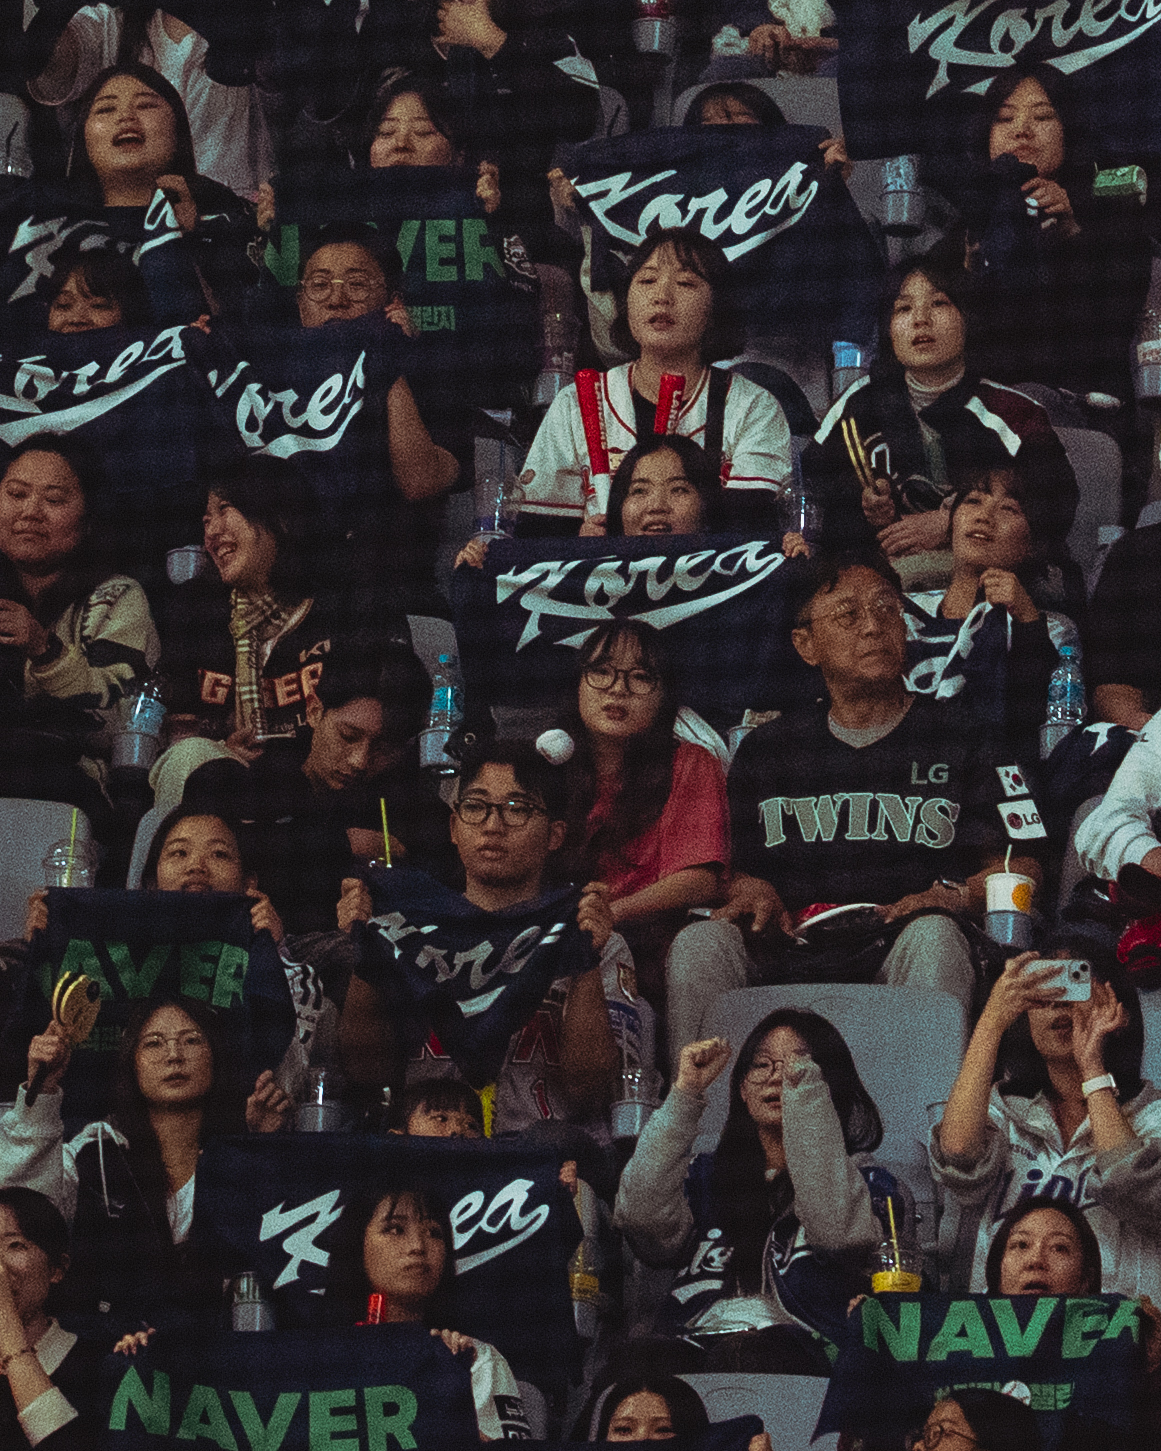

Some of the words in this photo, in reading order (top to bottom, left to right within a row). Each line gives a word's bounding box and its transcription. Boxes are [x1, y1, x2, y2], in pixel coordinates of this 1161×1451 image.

[574, 161, 818, 249] Korea
[495, 539, 785, 651] Korea
[911, 761, 949, 785] LG
[757, 792, 959, 849] TWINS
[108, 1366, 420, 1451] NAVER
